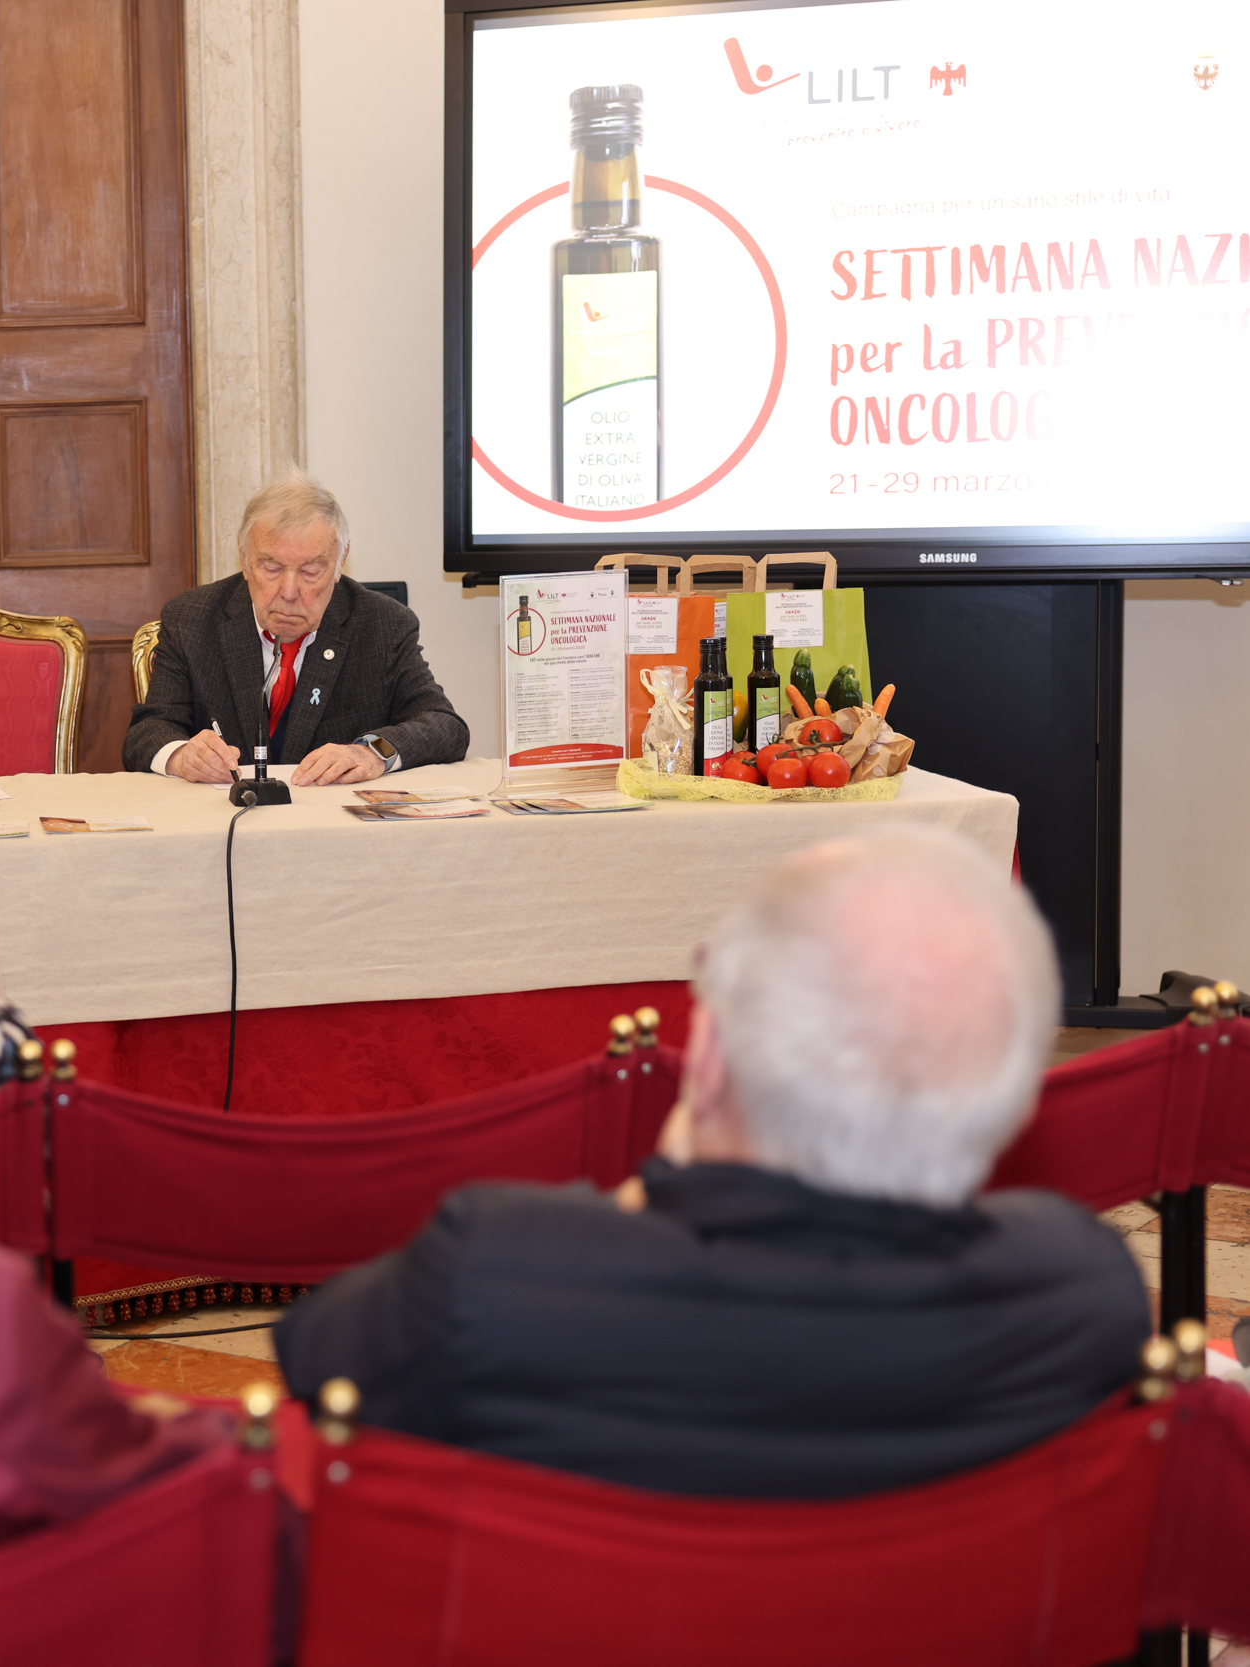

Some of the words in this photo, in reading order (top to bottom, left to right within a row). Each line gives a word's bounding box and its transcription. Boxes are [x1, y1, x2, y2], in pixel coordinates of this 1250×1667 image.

[807, 64, 902, 105] LILT
[829, 238, 1112, 303] SETTIMANA
[829, 341, 904, 388] per
[922, 322, 971, 372] la
[590, 410, 630, 425] OLIO
[585, 431, 636, 446] EXTRA
[578, 451, 642, 467] VERGINE
[578, 473, 593, 487] DI
[597, 472, 642, 487] OLIVA
[575, 493, 645, 508] ITALIANO
[919, 553, 978, 563] SAMSUNG
[550, 615, 583, 625] SETTIMANA
[584, 613, 616, 623] NAZIONALE
[568, 624, 608, 634] PREVENZIONE
[550, 635, 587, 645] ONCOLOGICA
